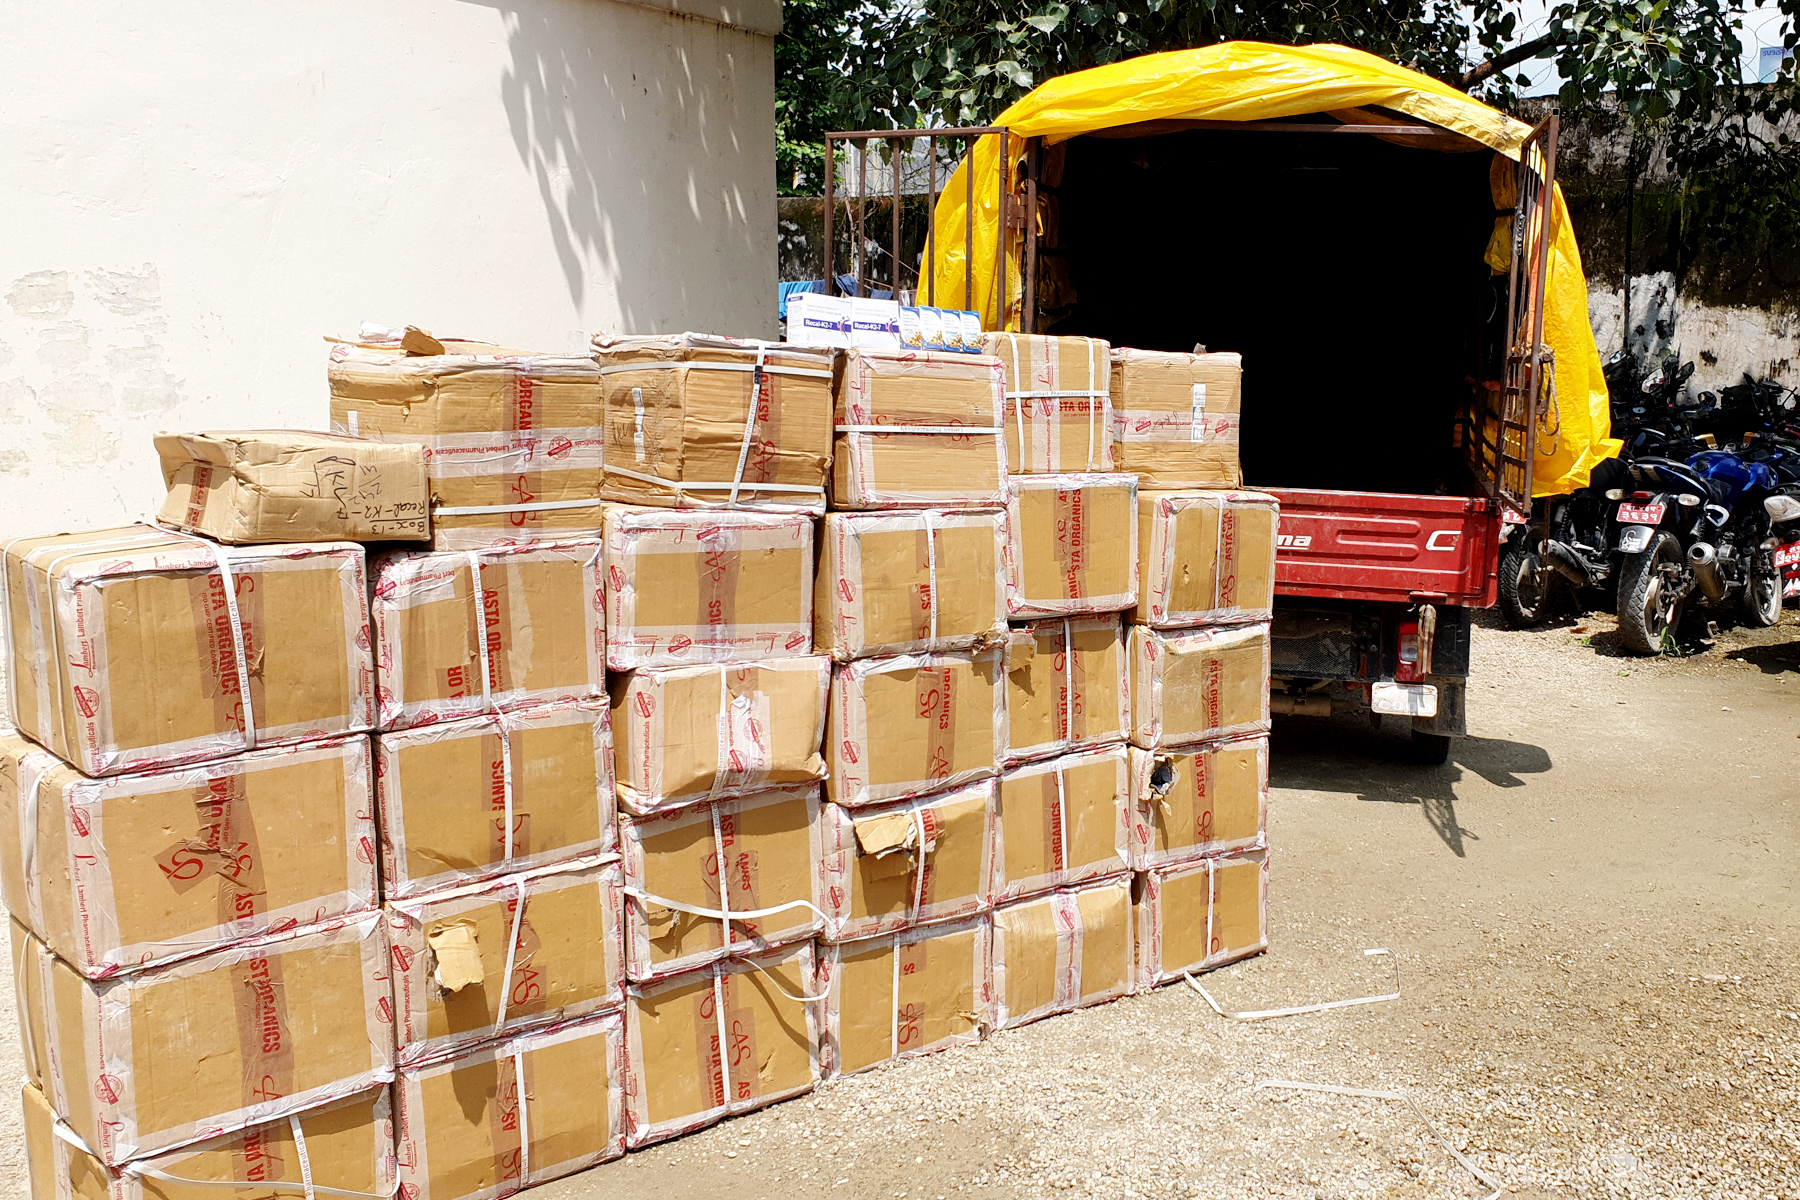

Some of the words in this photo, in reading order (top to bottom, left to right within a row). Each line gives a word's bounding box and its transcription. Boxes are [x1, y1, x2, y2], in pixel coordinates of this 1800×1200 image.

[1071, 489, 1081, 547] ORGANICS
[77, 604, 85, 638] Lambert
[483, 589, 501, 626] ASTA
[642, 721, 650, 767] Pharmaceuticals
[1196, 770, 1206, 797] ASTA
[721, 814, 735, 848] ASTA
[401, 974, 410, 1023] Pharmaceuticals
[401, 1115, 410, 1142] Lambert
